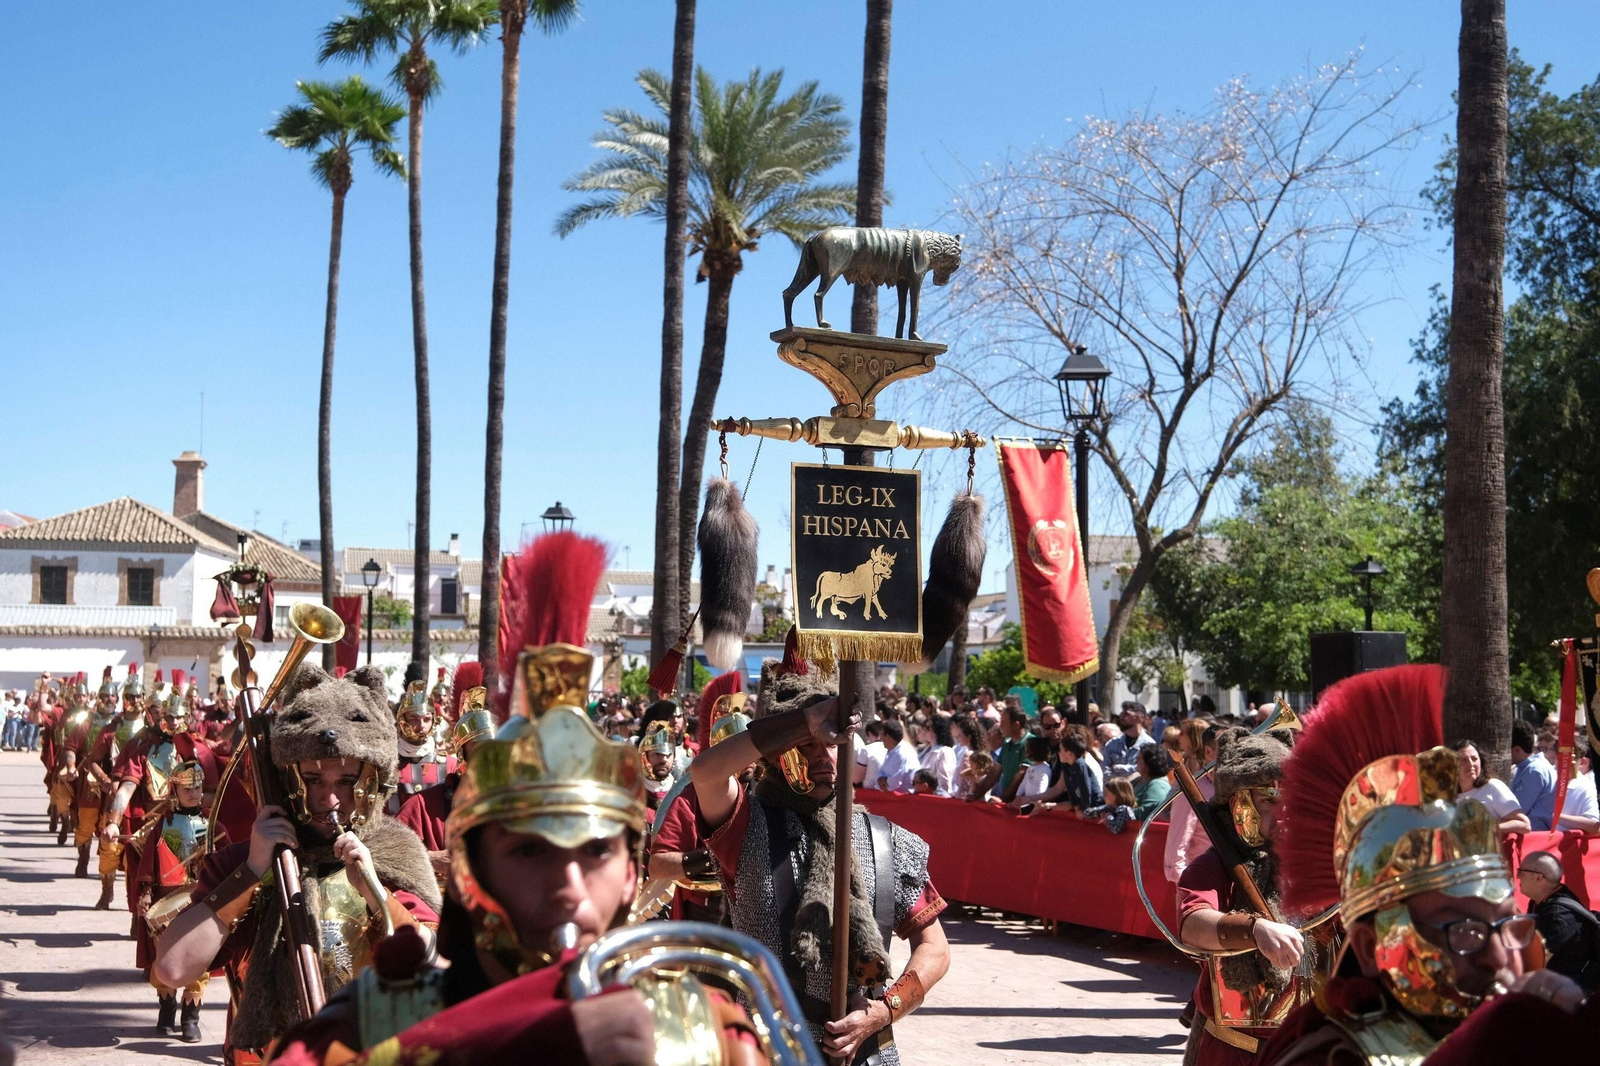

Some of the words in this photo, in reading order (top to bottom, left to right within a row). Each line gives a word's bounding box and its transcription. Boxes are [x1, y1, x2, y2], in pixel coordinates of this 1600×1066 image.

[839, 352, 896, 378] SPQR
[816, 484, 896, 508] LEG-IX
[802, 515, 911, 539] HISPANA
